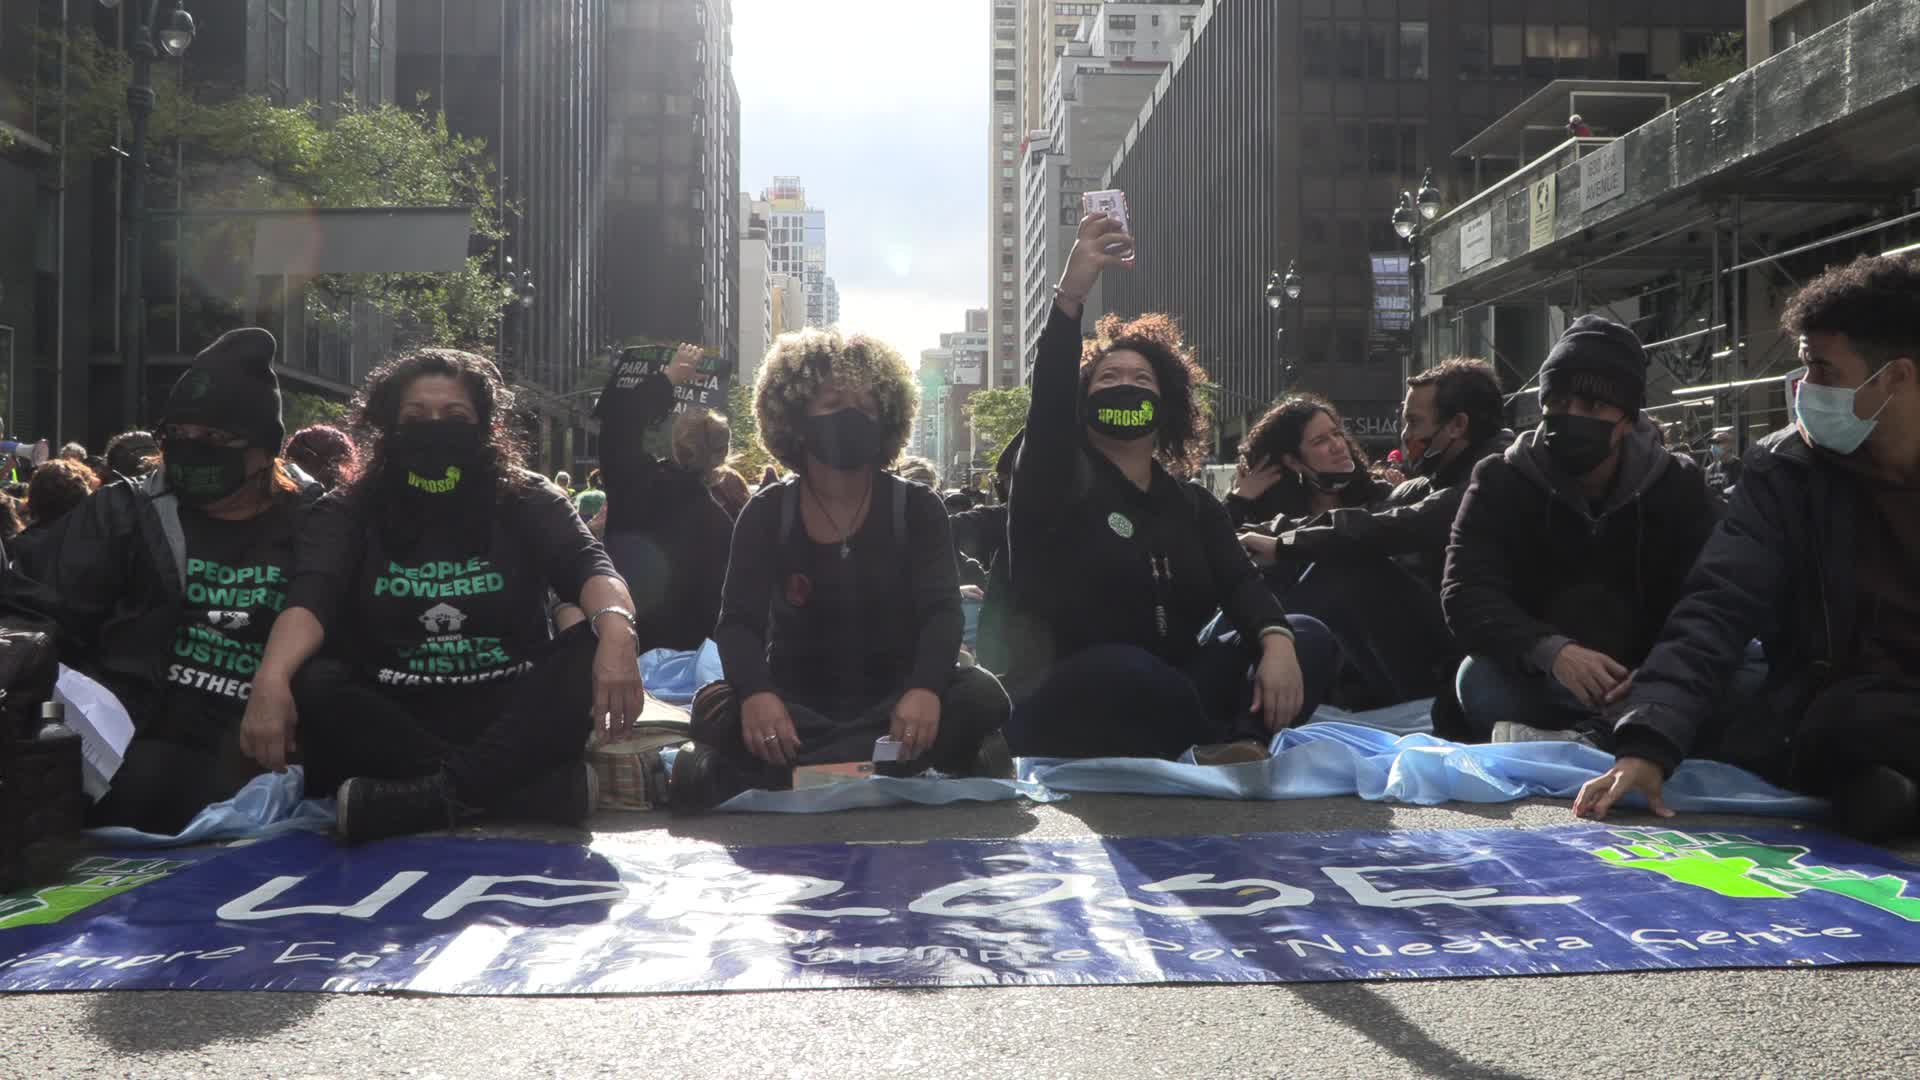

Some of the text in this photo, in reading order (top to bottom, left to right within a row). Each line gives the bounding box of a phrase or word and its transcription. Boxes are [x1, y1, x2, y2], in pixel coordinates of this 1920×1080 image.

[1585, 172, 1618, 201] AVENUE
[618, 361, 649, 375] PARA
[373, 572, 505, 598] POWERED
[0, 945, 247, 970] iempre
[273, 940, 382, 969] En
[1123, 936, 1258, 961] Por
[1276, 930, 1595, 958] Nuestra
[1630, 922, 1864, 951] Gente
